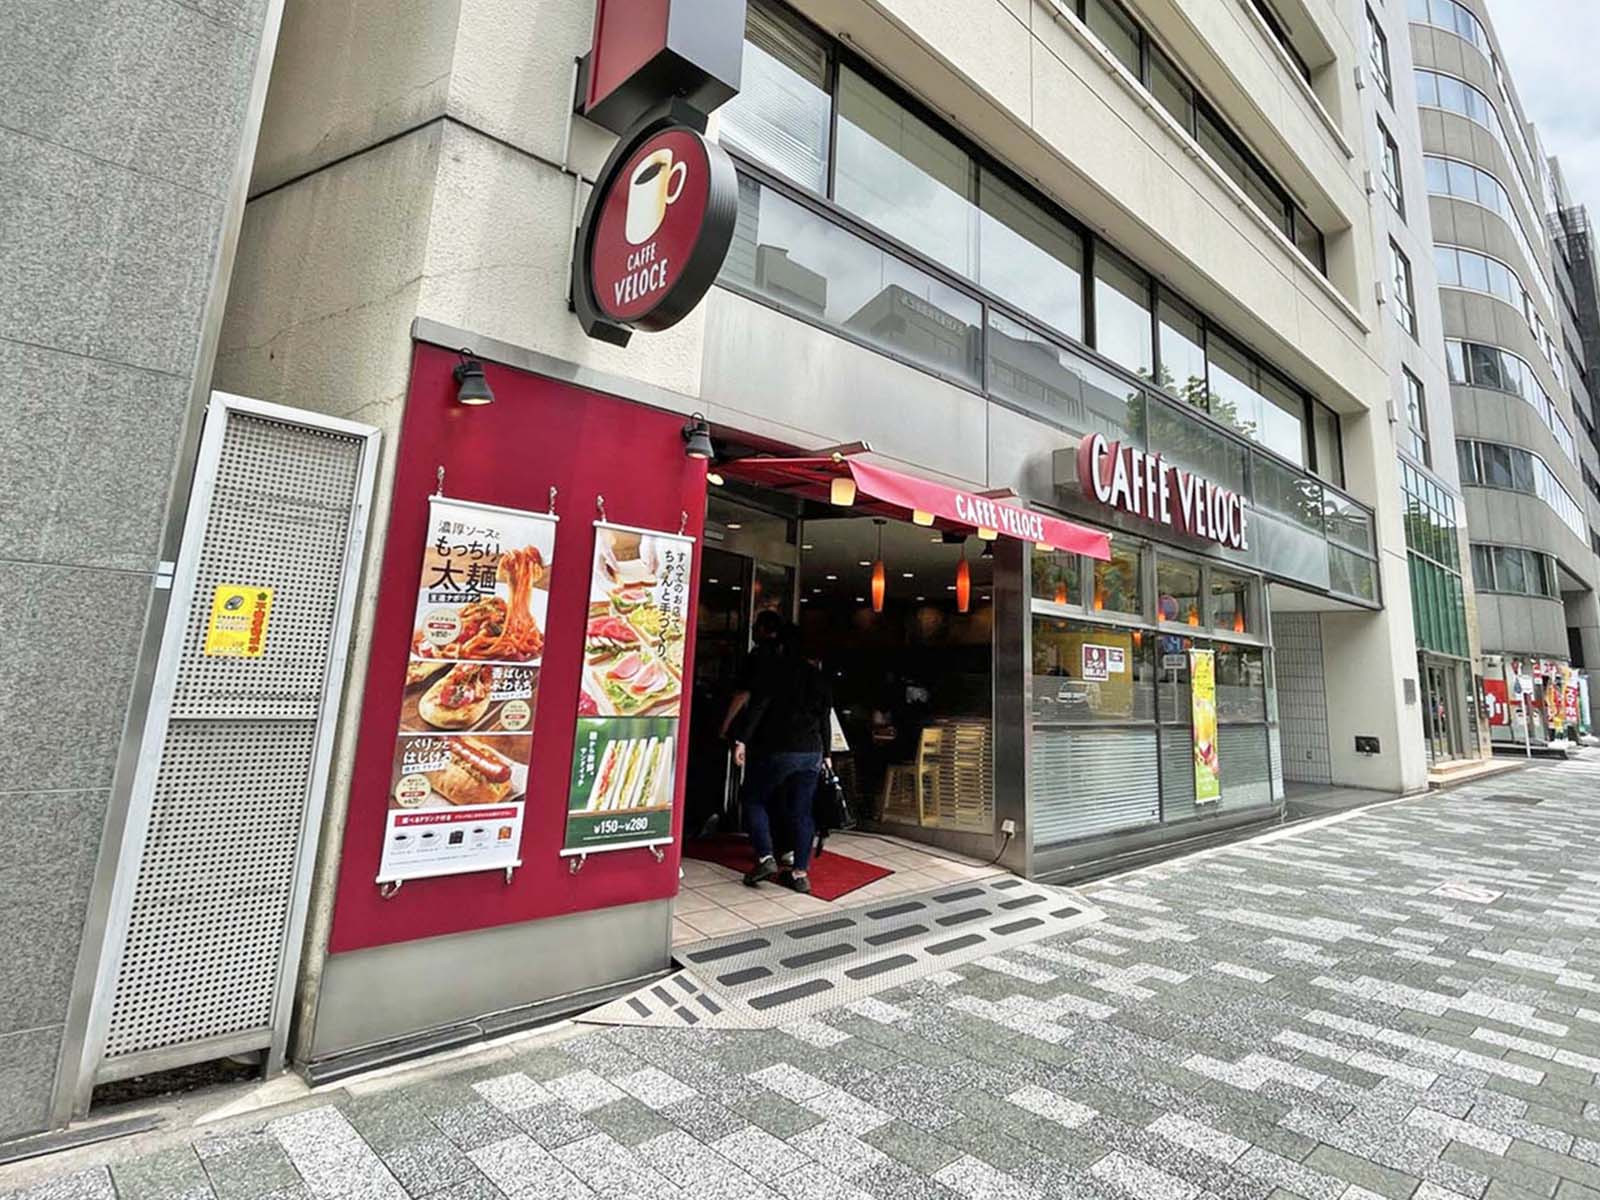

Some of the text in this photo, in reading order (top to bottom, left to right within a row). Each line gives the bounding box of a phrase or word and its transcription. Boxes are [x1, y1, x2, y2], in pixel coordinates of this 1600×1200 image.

[614, 258, 668, 307] VELOCE
[999, 506, 1044, 541] VELOCE
[1175, 466, 1248, 551] VELOCE
[434, 536, 502, 562] もっちり
[429, 560, 498, 595] 太麺
